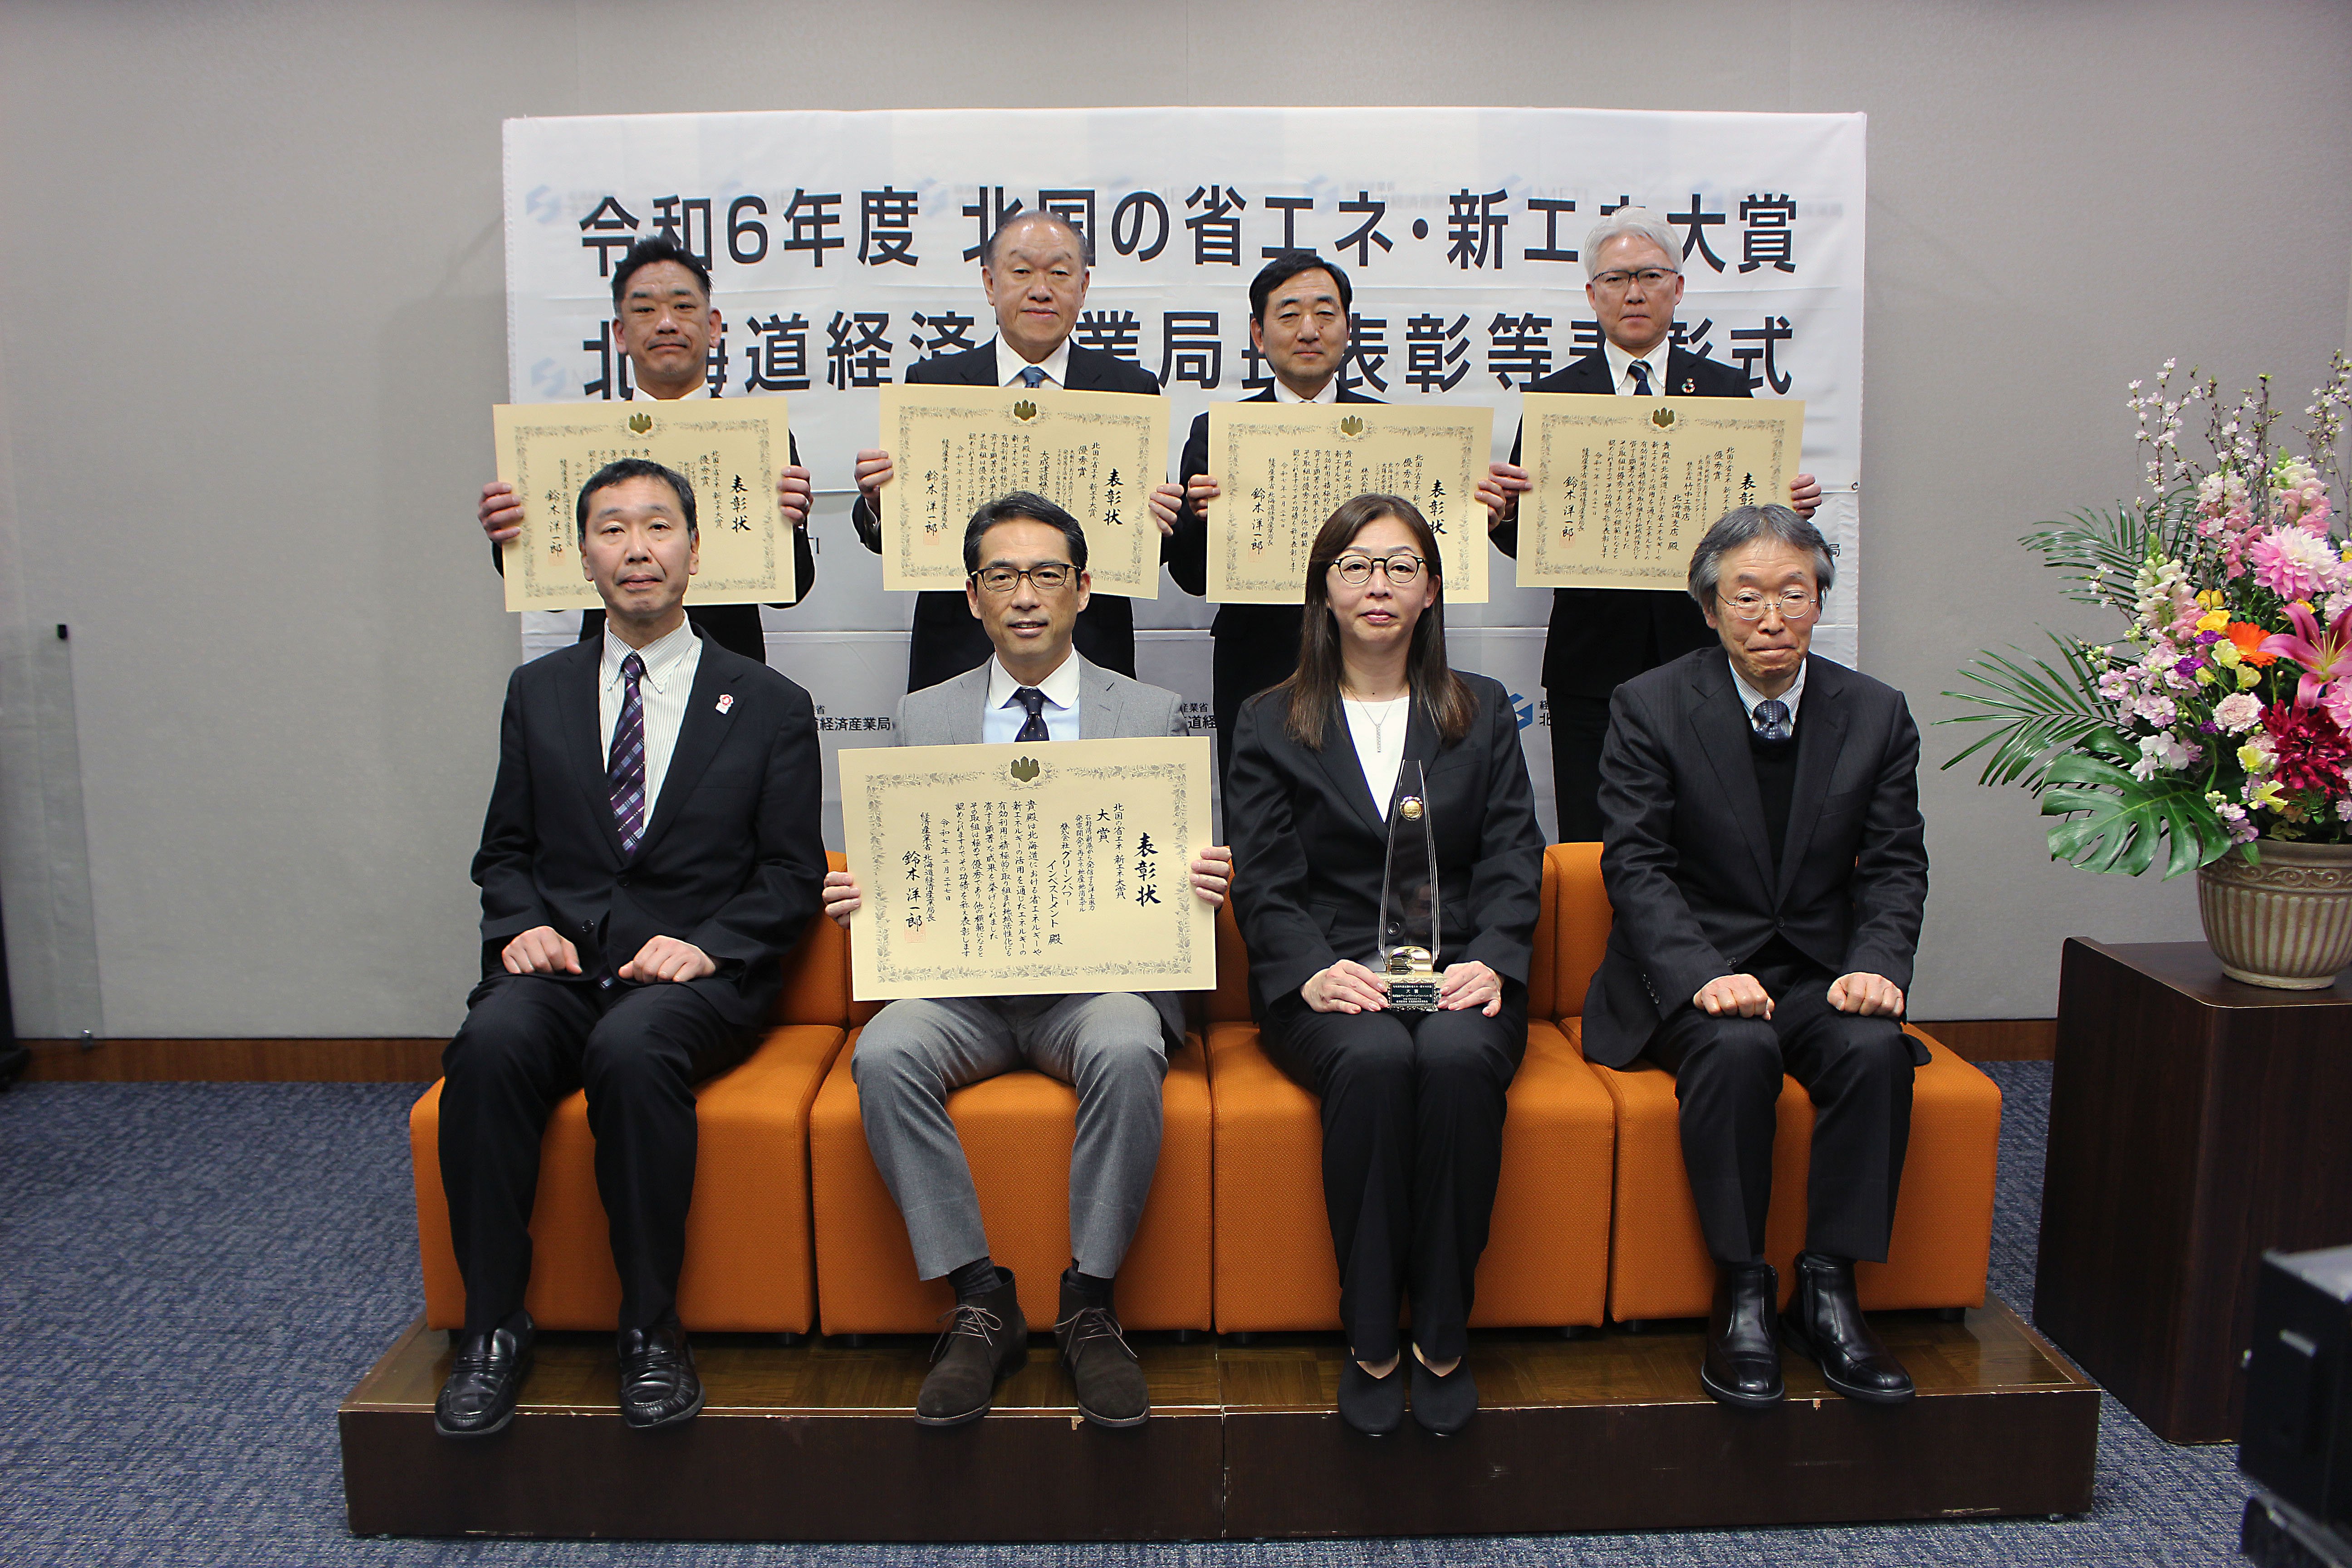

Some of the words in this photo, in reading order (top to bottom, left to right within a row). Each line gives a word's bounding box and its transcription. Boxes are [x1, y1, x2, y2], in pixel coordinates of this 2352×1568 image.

[578, 186, 919, 275] 令和6年度
[962, 184, 1798, 274] 北国の省エネ・新エ大賞
[729, 474, 751, 534] 表彰状
[1103, 468, 1124, 526] 表彰状
[1428, 479, 1448, 534] 表彰状
[1722, 446, 1735, 514] 北国の省エネ・新エネ大
[816, 716, 890, 730] 経済産業局
[1184, 715, 1216, 729] 道経
[1096, 809, 1111, 843] 大賞
[1113, 803, 1126, 900] 北国の省エネ・新エネ大賞
[984, 801, 998, 940] 資する顕著な成果を挙げられました
[997, 801, 1013, 956] 有効利用に積極的に取り組まれ地域活性化にも
[1011, 800, 1027, 956] 新エネルギーの活用を通じたエネルギーの
[1025, 799, 1042, 956] 貴殿は北海道における省エネルギーや
[1046, 860, 1059, 928] インベストメント
[1059, 822, 1073, 906] 株式会社グリーンパワー
[1134, 832, 1162, 907] 表彰状
[1048, 933, 1063, 946] 殿
